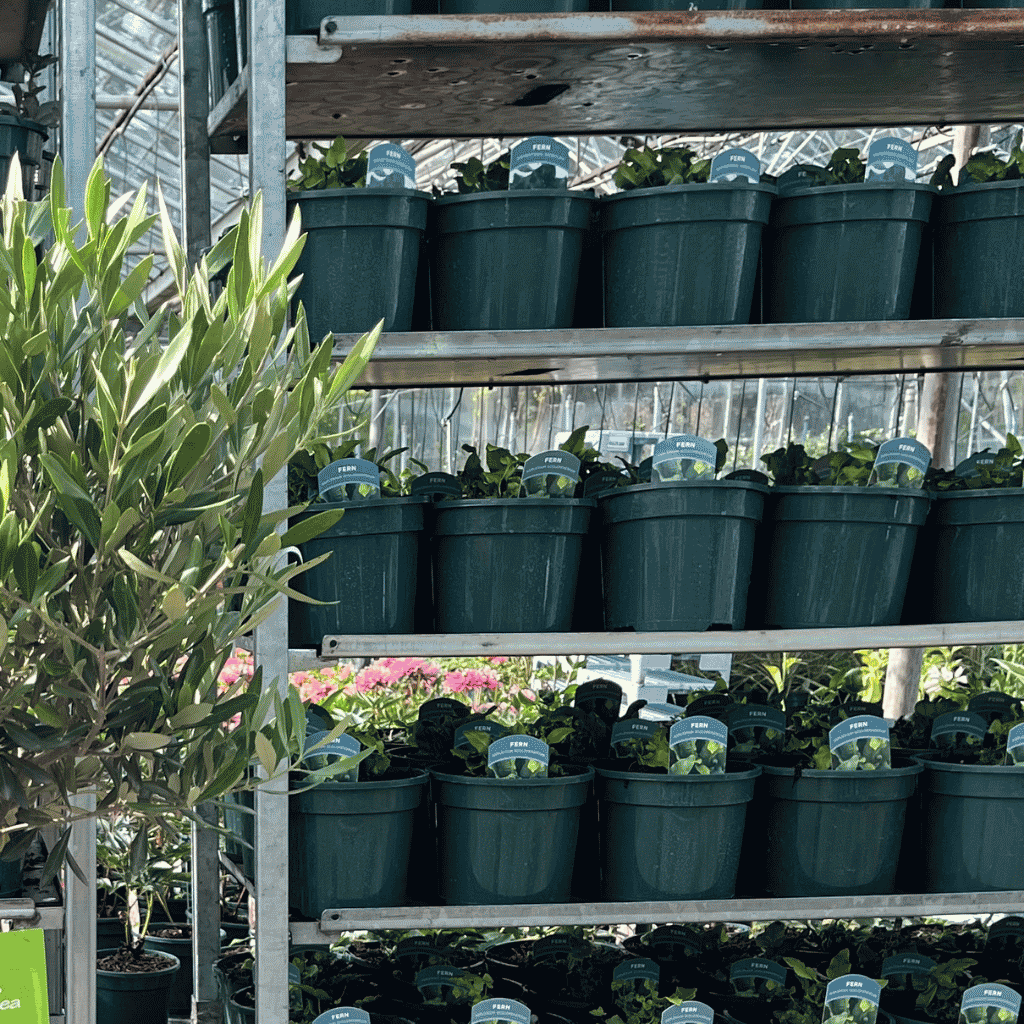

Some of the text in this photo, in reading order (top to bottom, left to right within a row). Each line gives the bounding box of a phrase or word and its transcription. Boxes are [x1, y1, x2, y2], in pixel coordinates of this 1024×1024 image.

[887, 143, 903, 151] FERN
[386, 150, 401, 158] FERN
[899, 444, 915, 452] FERN
[338, 465, 357, 473] FERN
[849, 721, 868, 730] FERN
[751, 962, 769, 970] FERN
[492, 1003, 511, 1011] FERN
[332, 1012, 349, 1020] FERN
